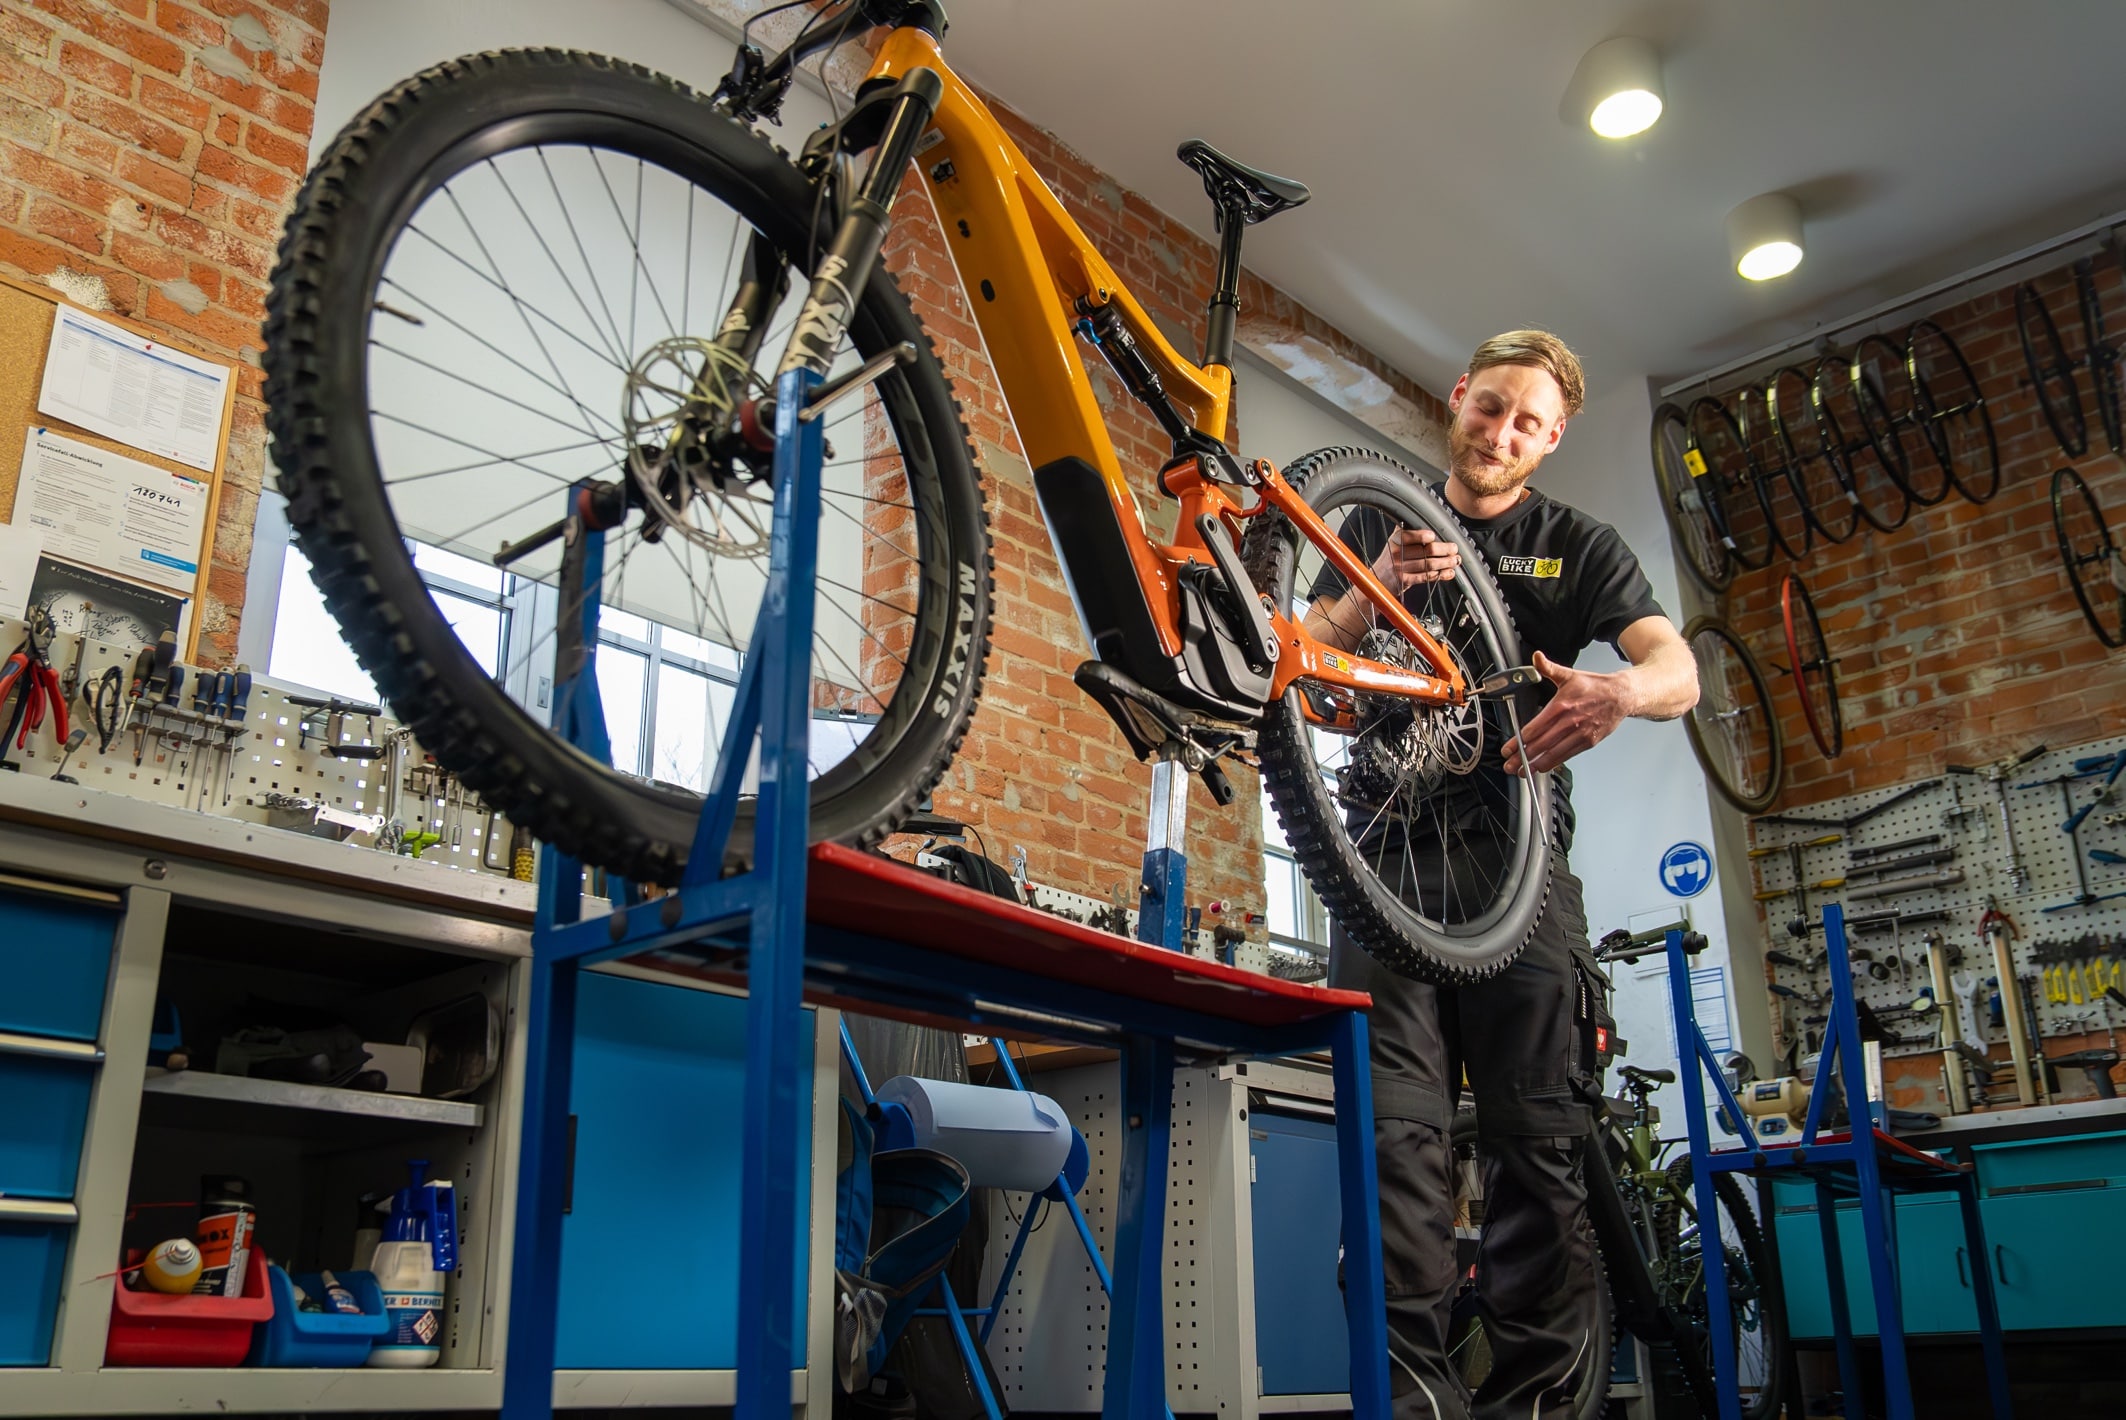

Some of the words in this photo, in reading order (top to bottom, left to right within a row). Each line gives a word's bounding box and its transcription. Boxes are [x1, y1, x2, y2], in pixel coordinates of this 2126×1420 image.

[1503, 558, 1534, 566] LUCKY
[1501, 564, 1532, 573] BIKE
[933, 560, 976, 719] MAXXIS
